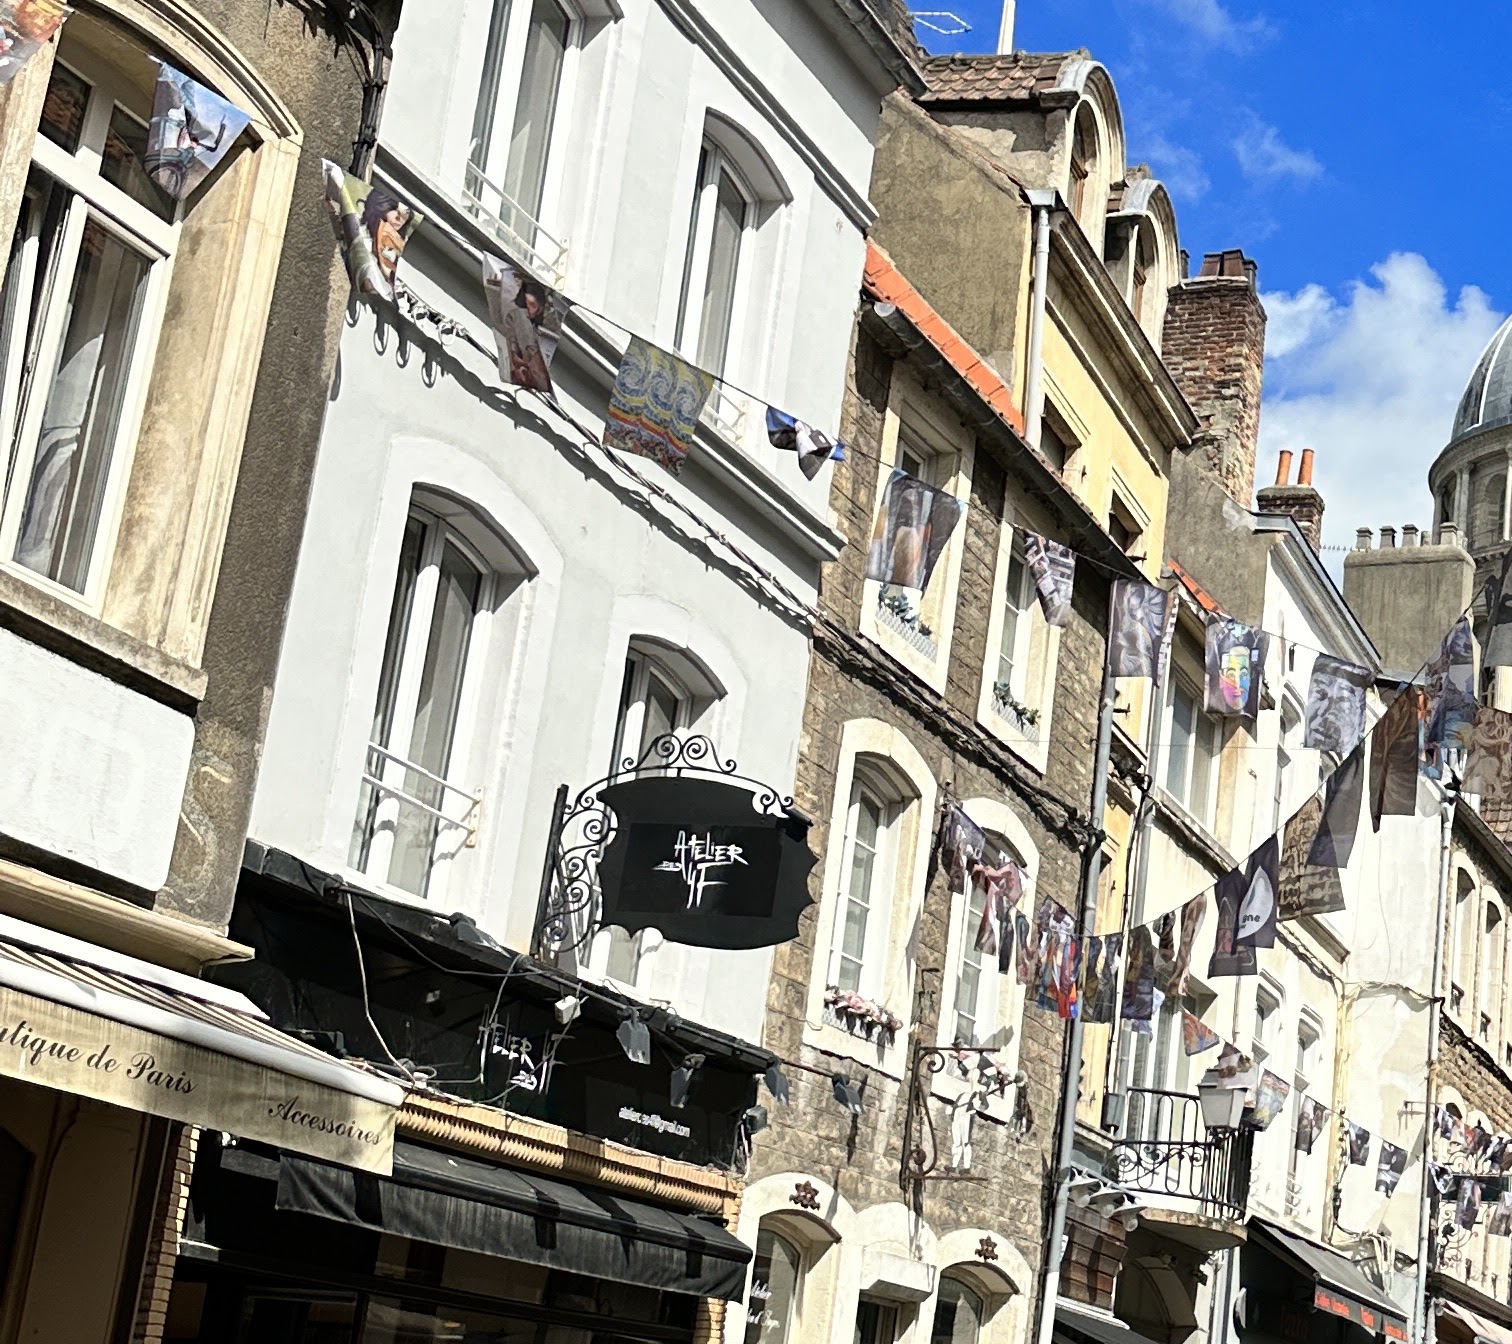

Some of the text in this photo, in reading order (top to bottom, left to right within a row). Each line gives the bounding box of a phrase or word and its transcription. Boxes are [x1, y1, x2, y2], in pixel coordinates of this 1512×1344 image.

[86, 1044, 123, 1073] de
[126, 1052, 201, 1095] Paris
[268, 1096, 385, 1147] Accessoires
